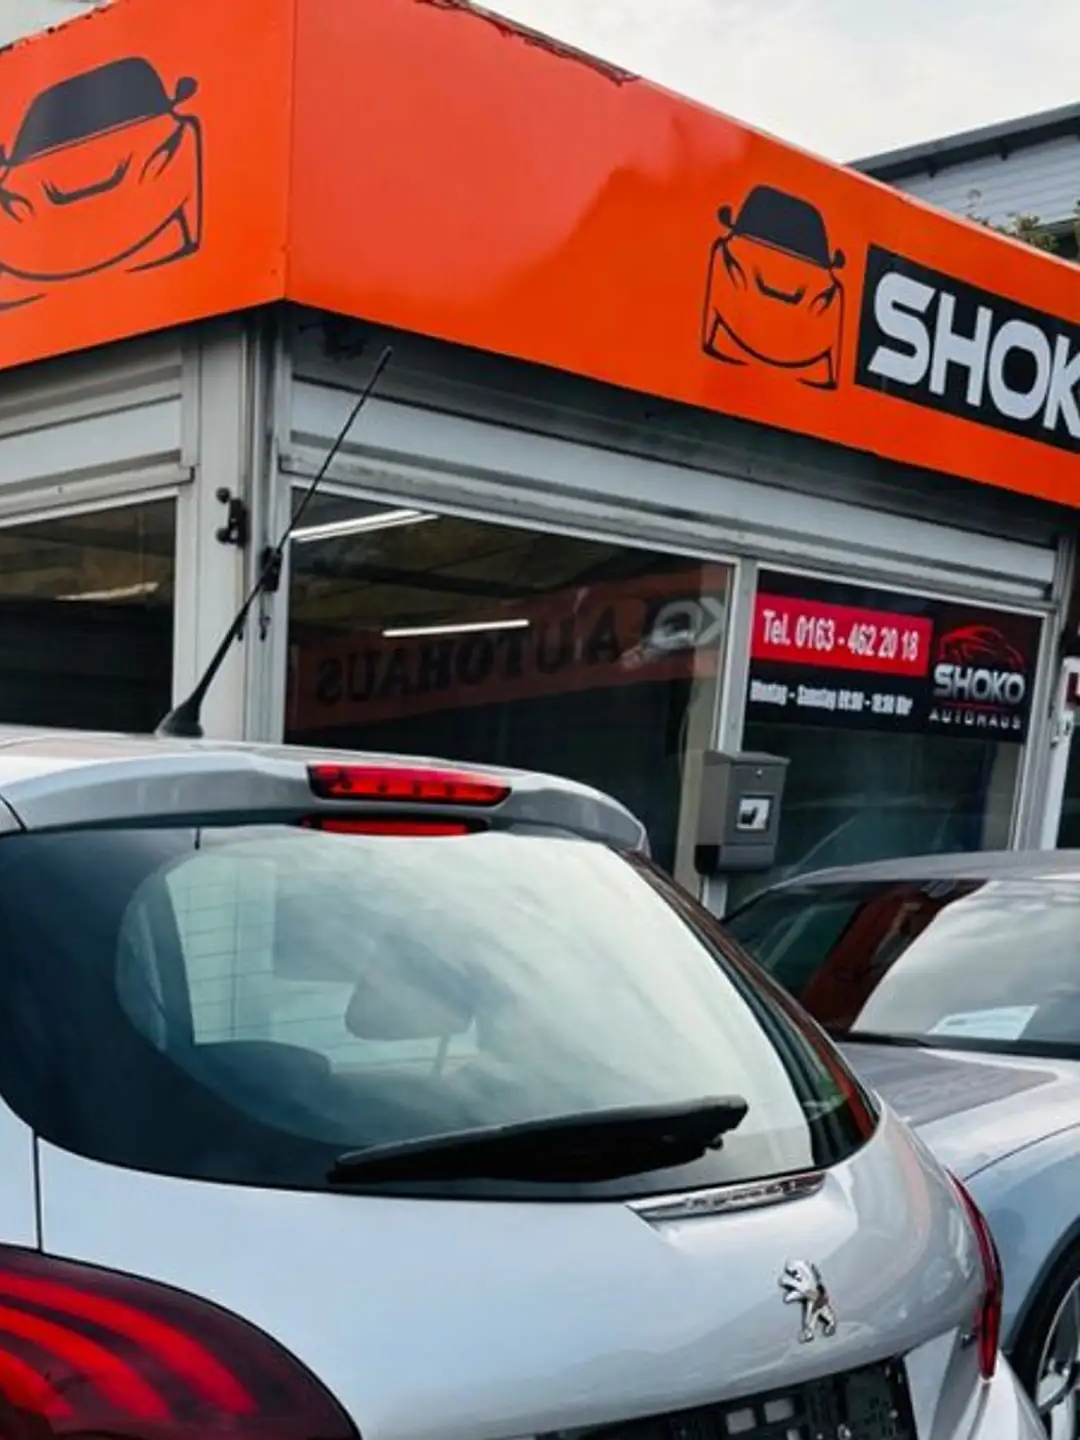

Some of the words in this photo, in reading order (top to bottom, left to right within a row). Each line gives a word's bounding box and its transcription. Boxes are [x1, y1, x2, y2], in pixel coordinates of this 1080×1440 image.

[762, 609, 791, 646] Tel.
[795, 614, 835, 652] 0163
[878, 626, 898, 660] 20
[933, 663, 1026, 704] SHOKO
[928, 707, 1022, 730] AUTOHAUS
